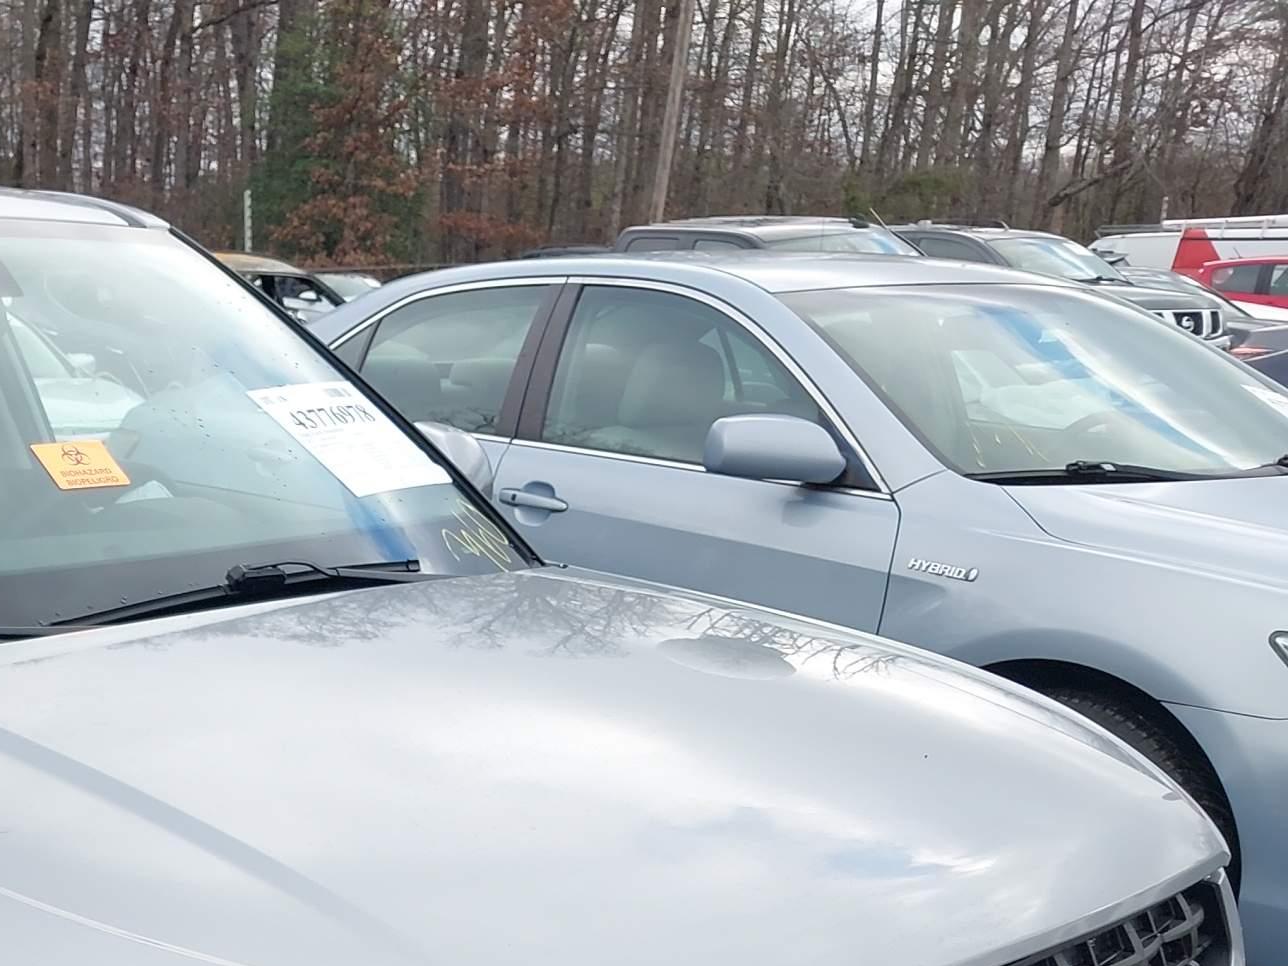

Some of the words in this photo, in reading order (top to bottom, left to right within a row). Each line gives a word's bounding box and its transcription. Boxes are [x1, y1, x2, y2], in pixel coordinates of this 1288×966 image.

[289, 403, 376, 430] 43776978
[60, 467, 113, 477] BIOHAZARD
[907, 558, 967, 579] HYBRID
